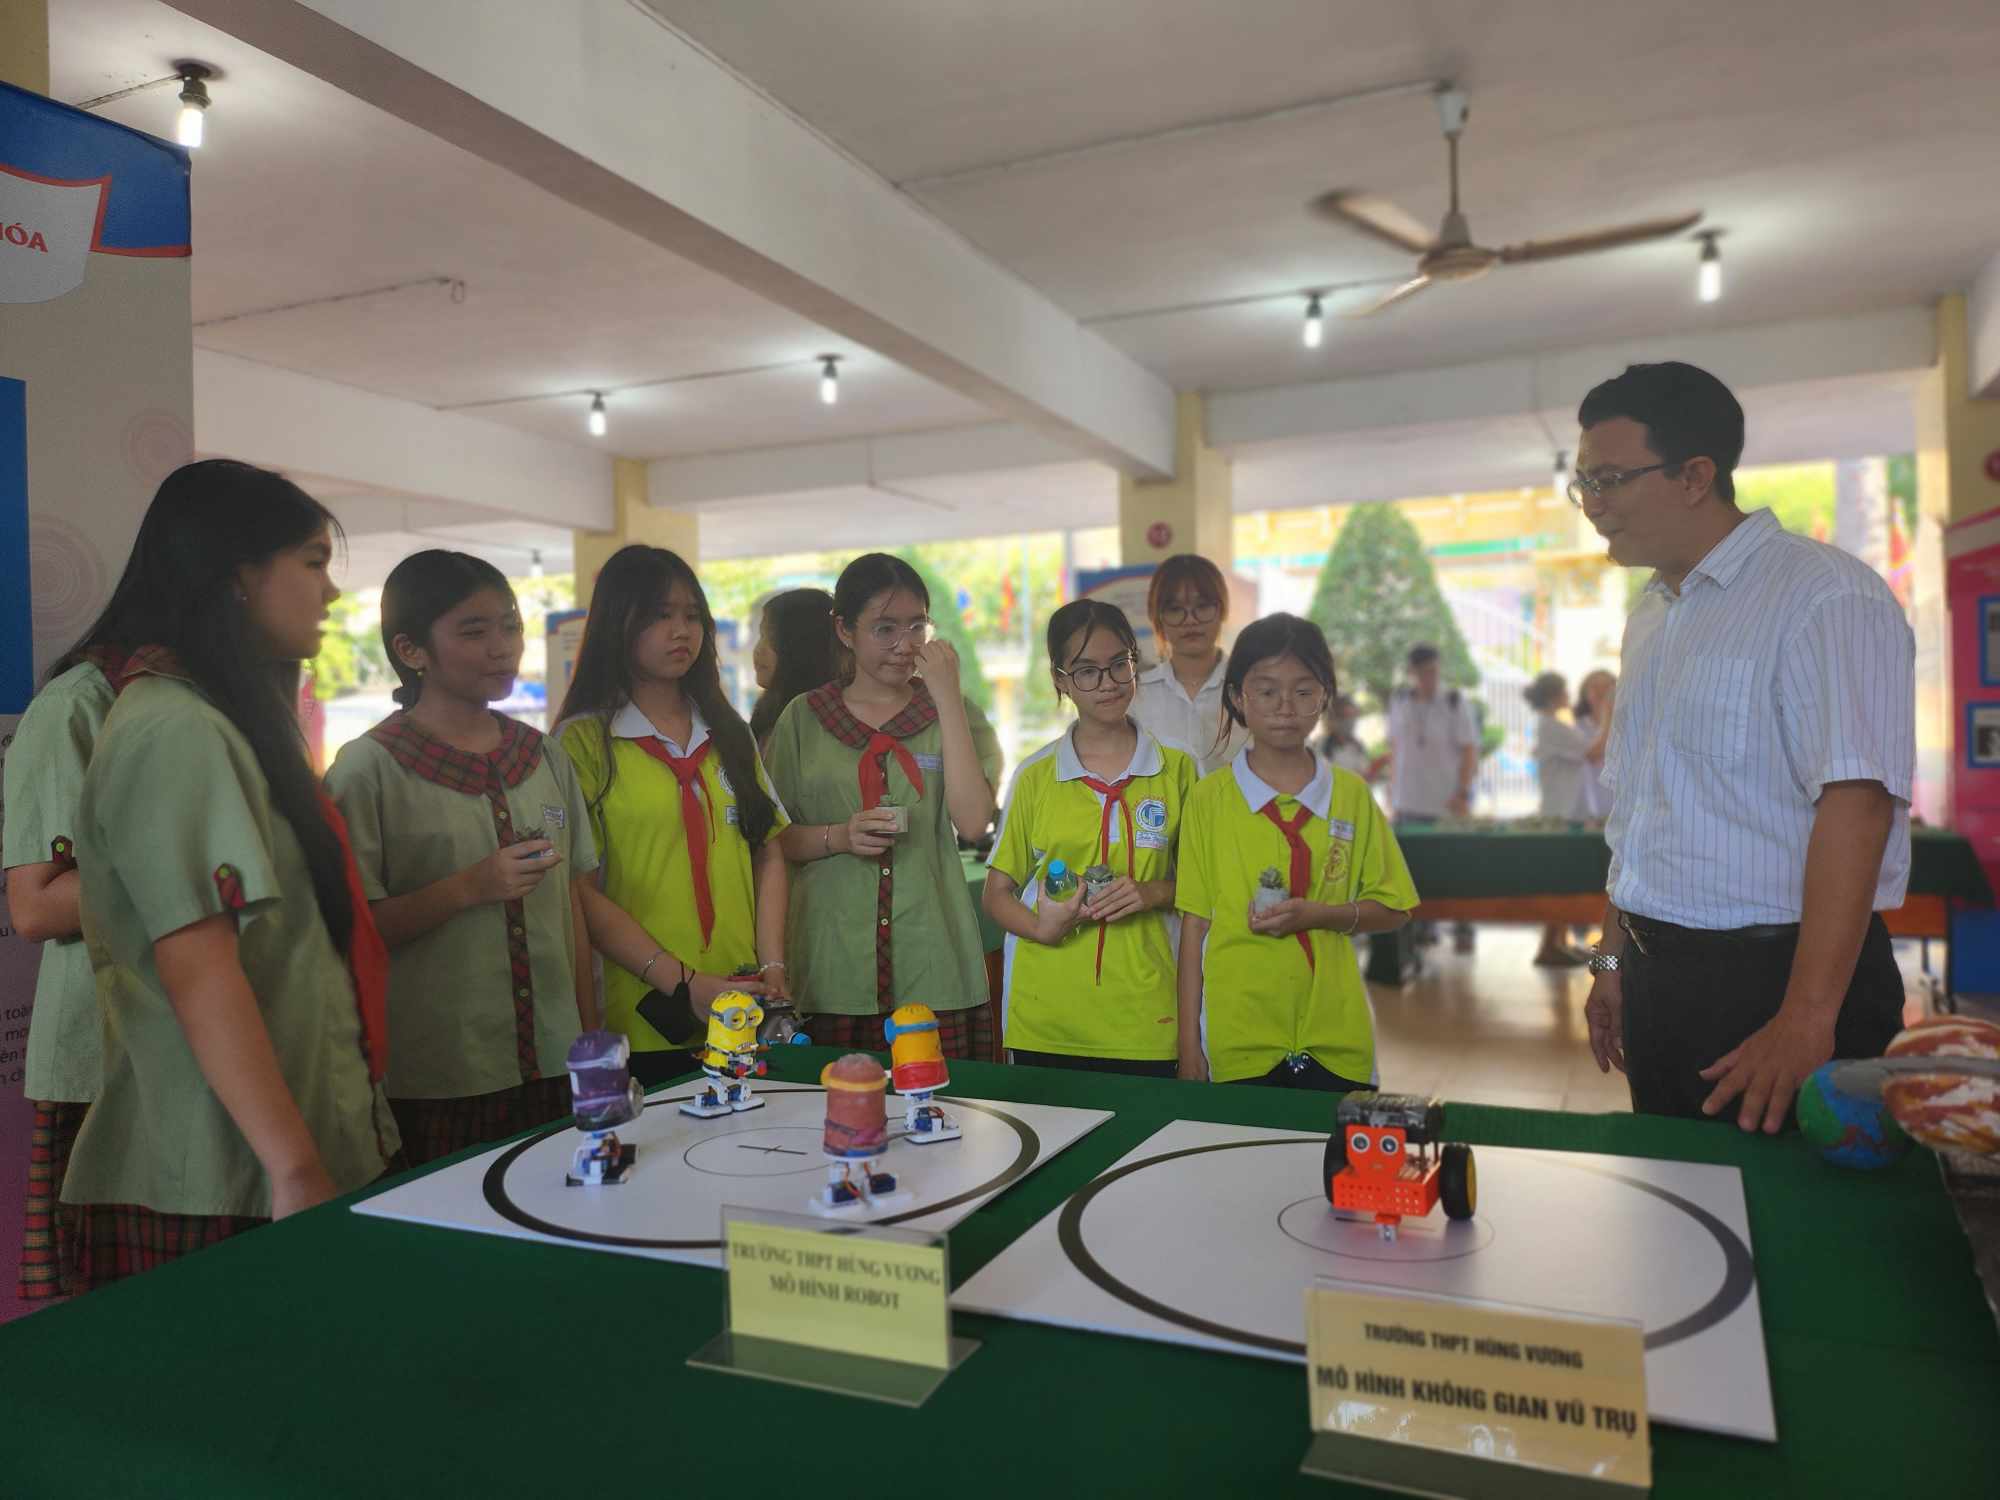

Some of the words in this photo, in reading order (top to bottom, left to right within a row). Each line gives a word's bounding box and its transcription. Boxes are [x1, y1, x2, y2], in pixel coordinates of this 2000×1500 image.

[0, 222, 48, 253] ÓA
[732, 1241, 792, 1267] TRƯỜNG
[797, 1249, 833, 1270] THPT
[837, 1251, 882, 1278] HÙNG
[884, 1260, 941, 1287] VƯƠNG
[769, 1272, 796, 1294] MÔ
[798, 1276, 840, 1301] HÌNH
[844, 1287, 900, 1310] ROBOT
[1363, 1323, 1426, 1348] TRƯỜNG
[1430, 1331, 1470, 1354] THPT
[1474, 1336, 1521, 1362] HÙNG
[1525, 1344, 1584, 1370] VƯƠNG
[1316, 1364, 1348, 1390] MÔ
[1354, 1368, 1405, 1399] HÌNH
[1411, 1379, 1487, 1412] KHÔNG
[1493, 1391, 1548, 1421] GIAN
[1555, 1399, 1585, 1426] VŨ
[1591, 1406, 1638, 1440] TRỤ
